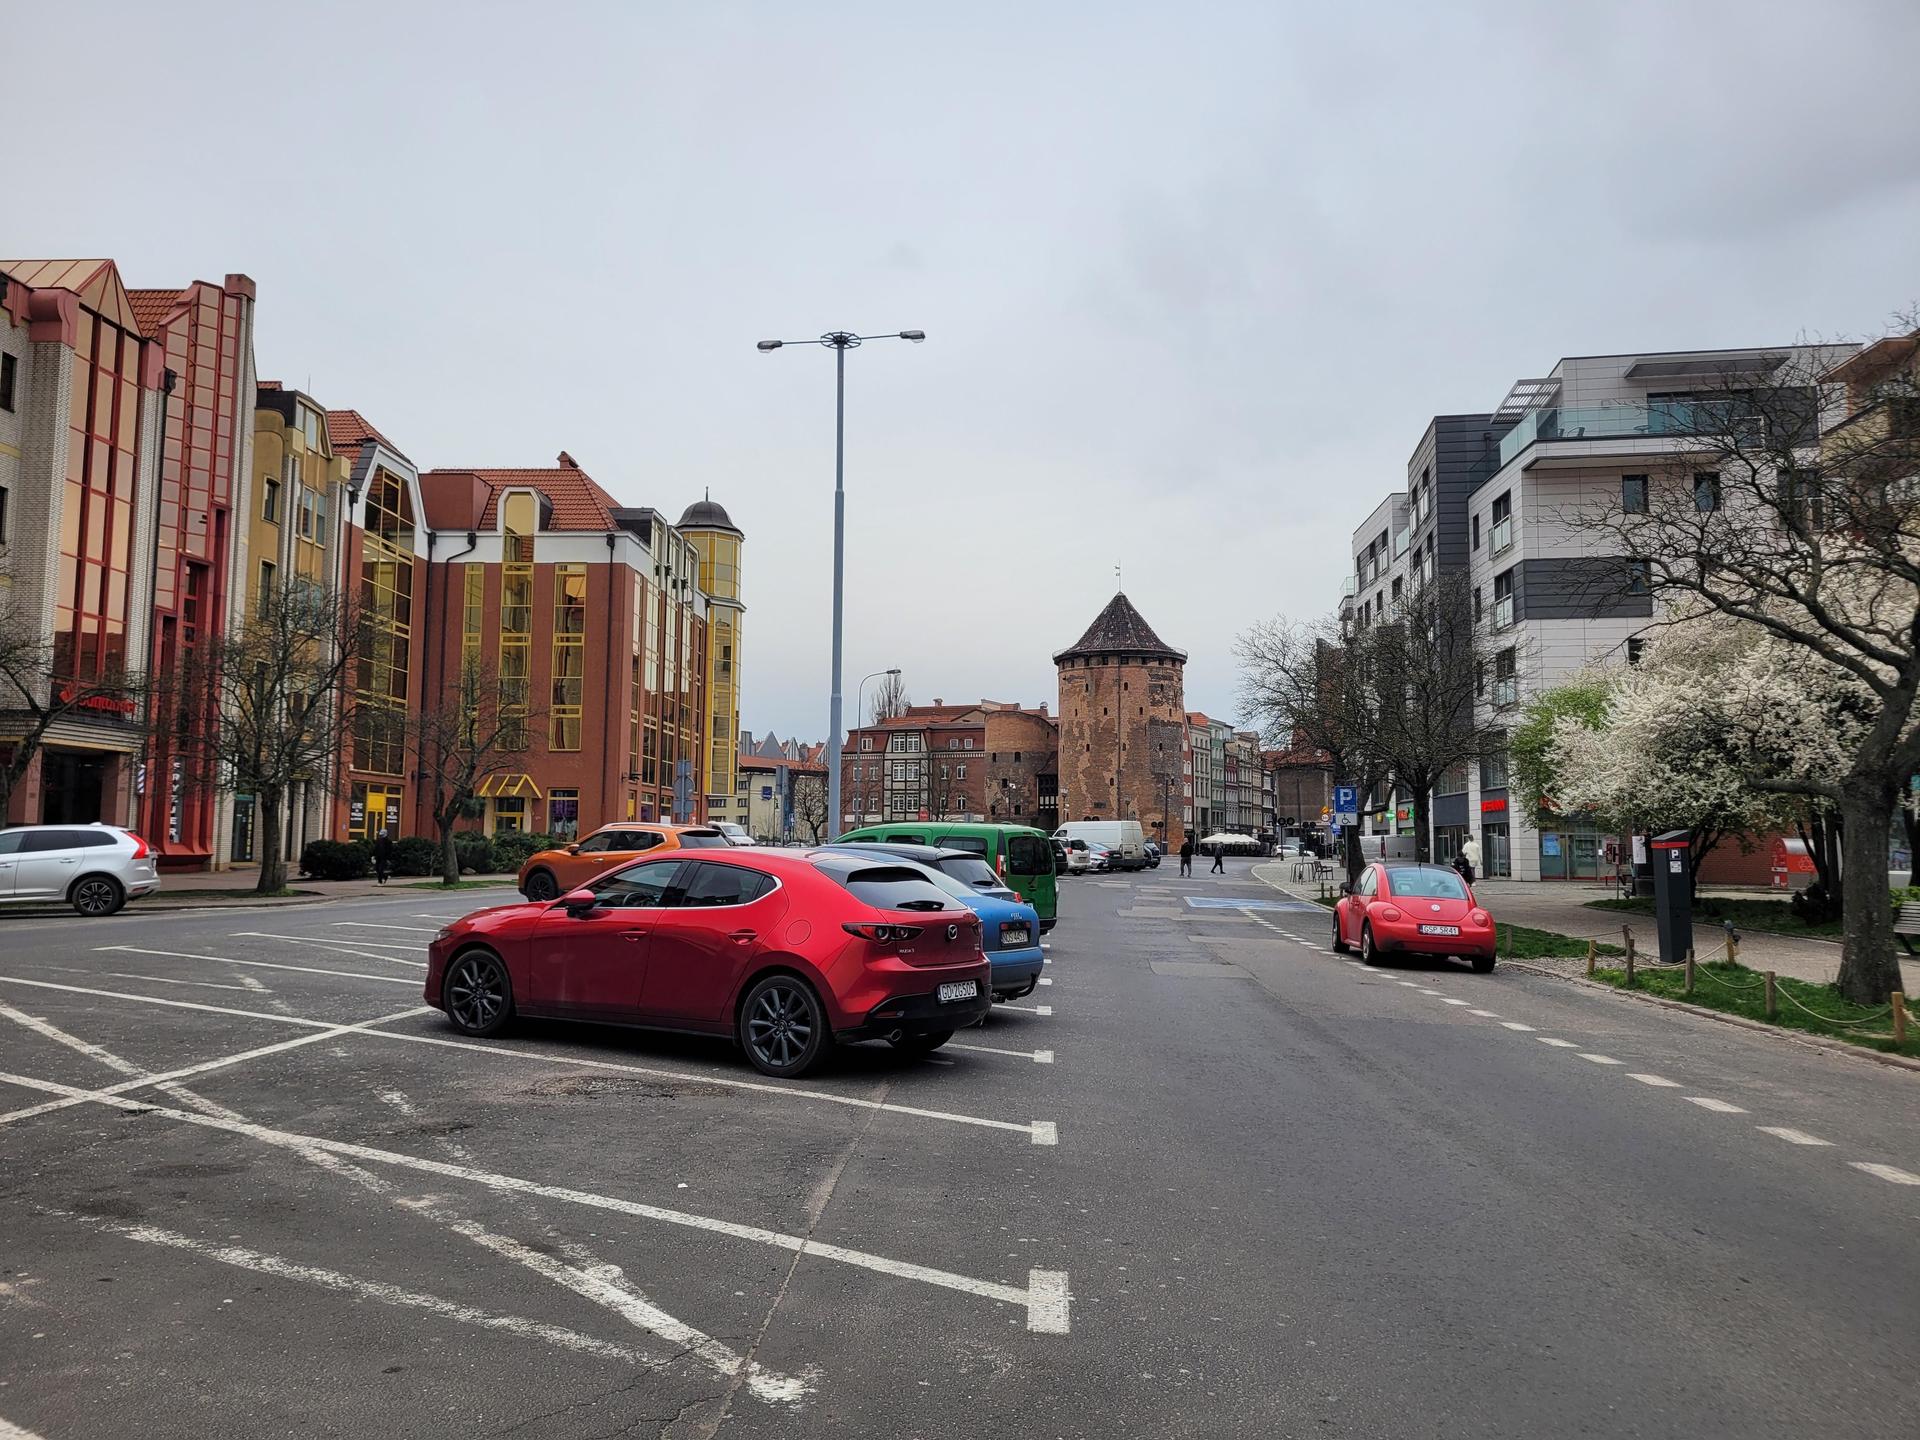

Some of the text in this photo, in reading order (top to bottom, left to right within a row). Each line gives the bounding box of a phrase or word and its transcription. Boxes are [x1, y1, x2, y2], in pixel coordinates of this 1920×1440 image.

[1340, 788, 1353, 805] P
[1671, 849, 1679, 859] P
[942, 984, 952, 999] GD
